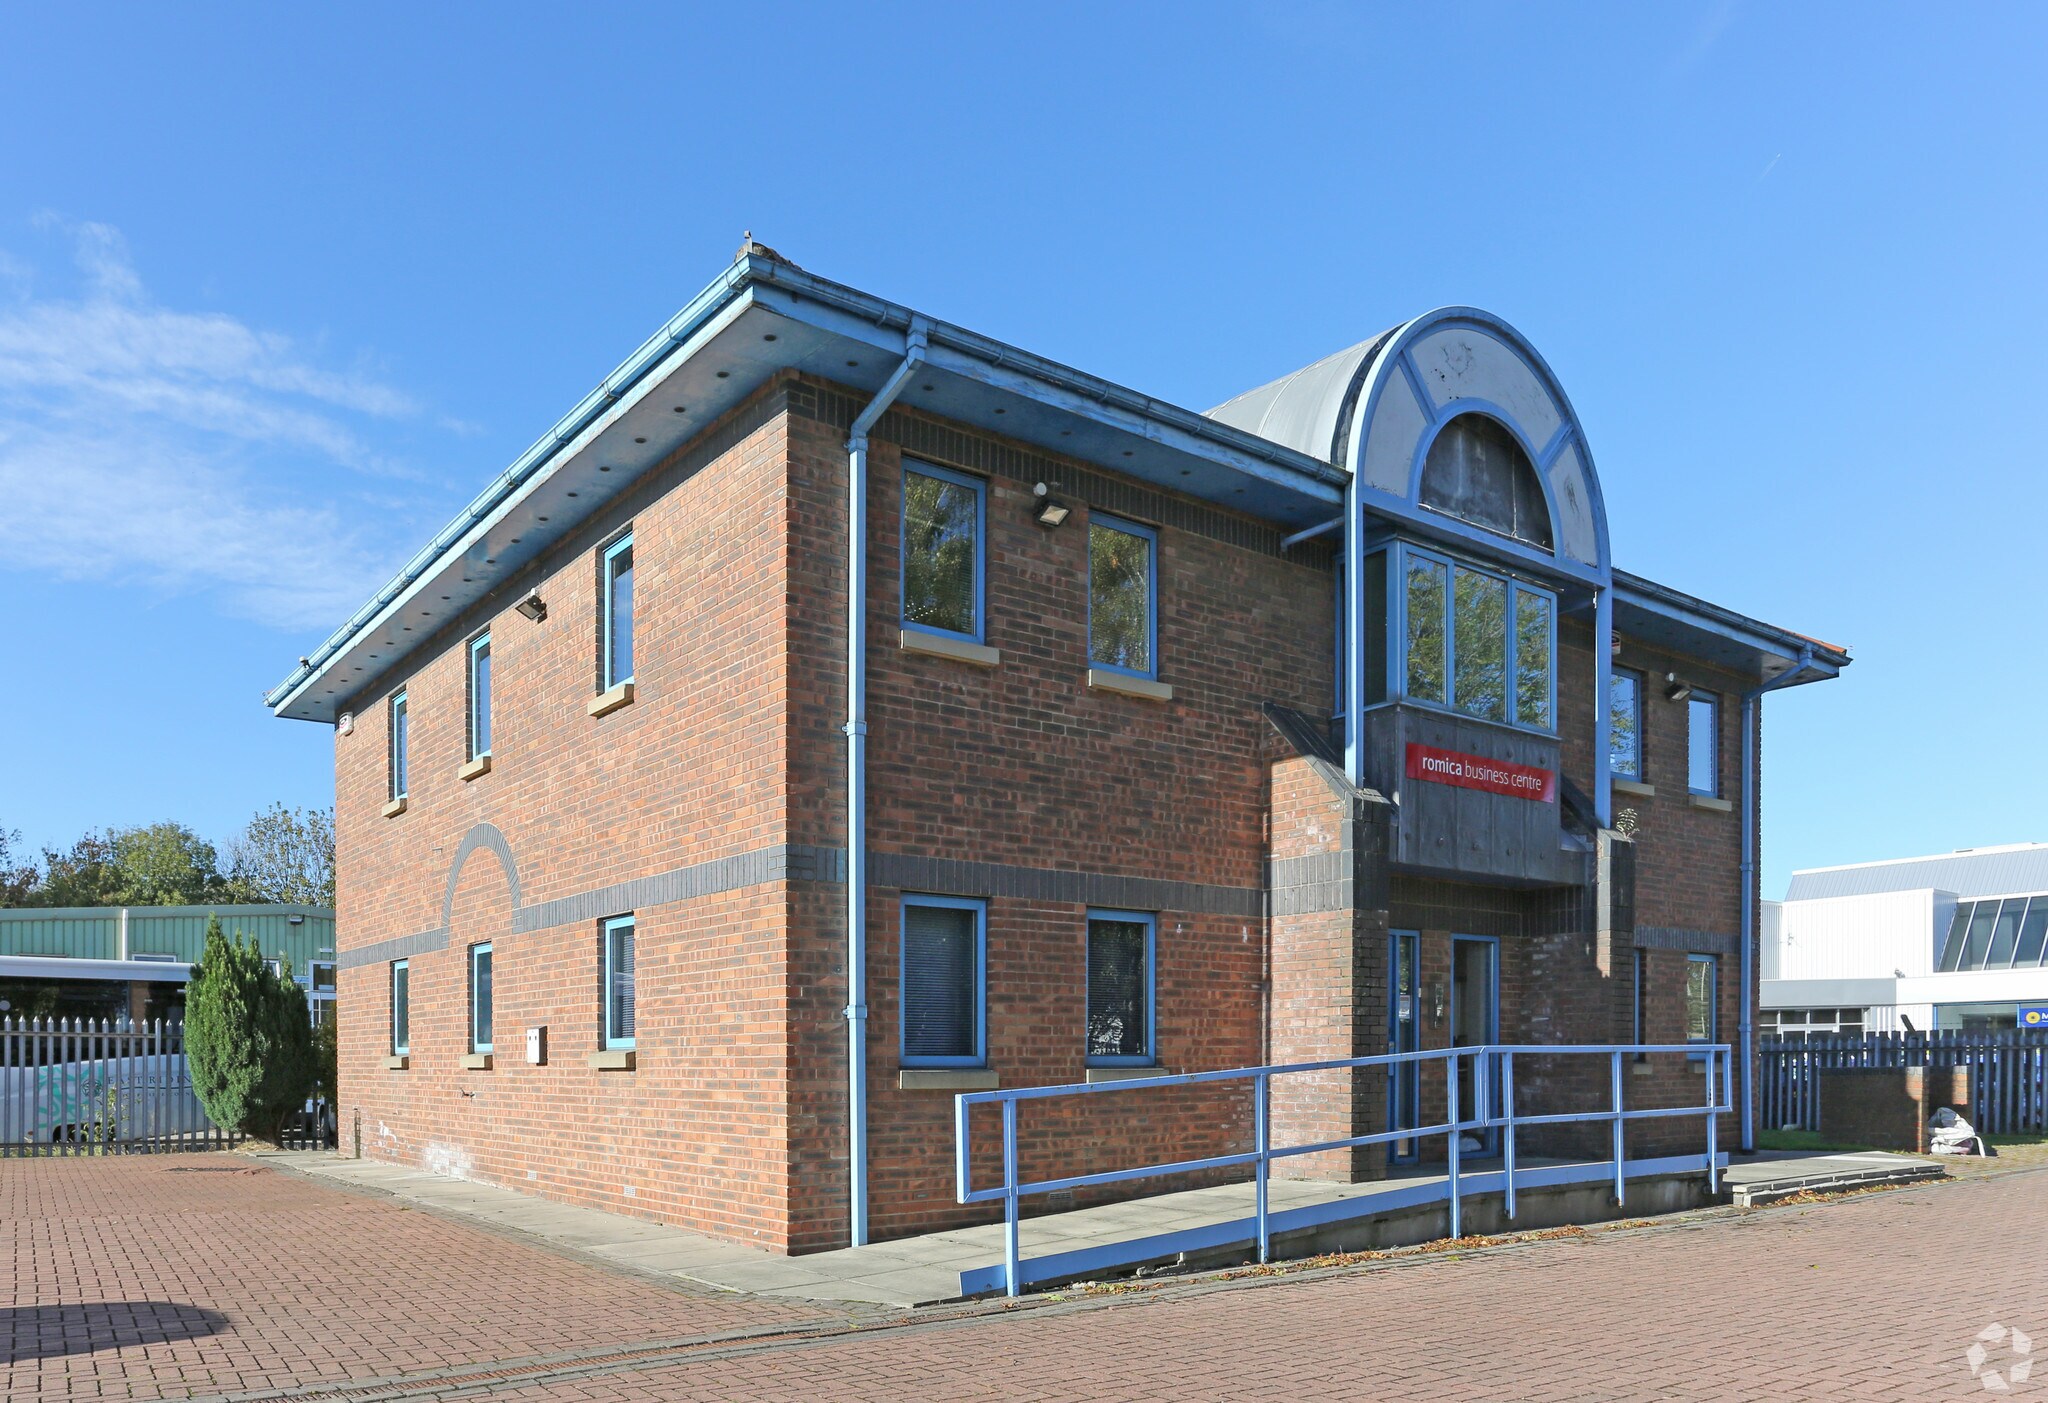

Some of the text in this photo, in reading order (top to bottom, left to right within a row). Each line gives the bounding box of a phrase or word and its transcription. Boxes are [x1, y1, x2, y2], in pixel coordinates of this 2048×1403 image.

[1422, 757, 1542, 791] romica business centre
[108, 1076, 144, 1085] EAT
